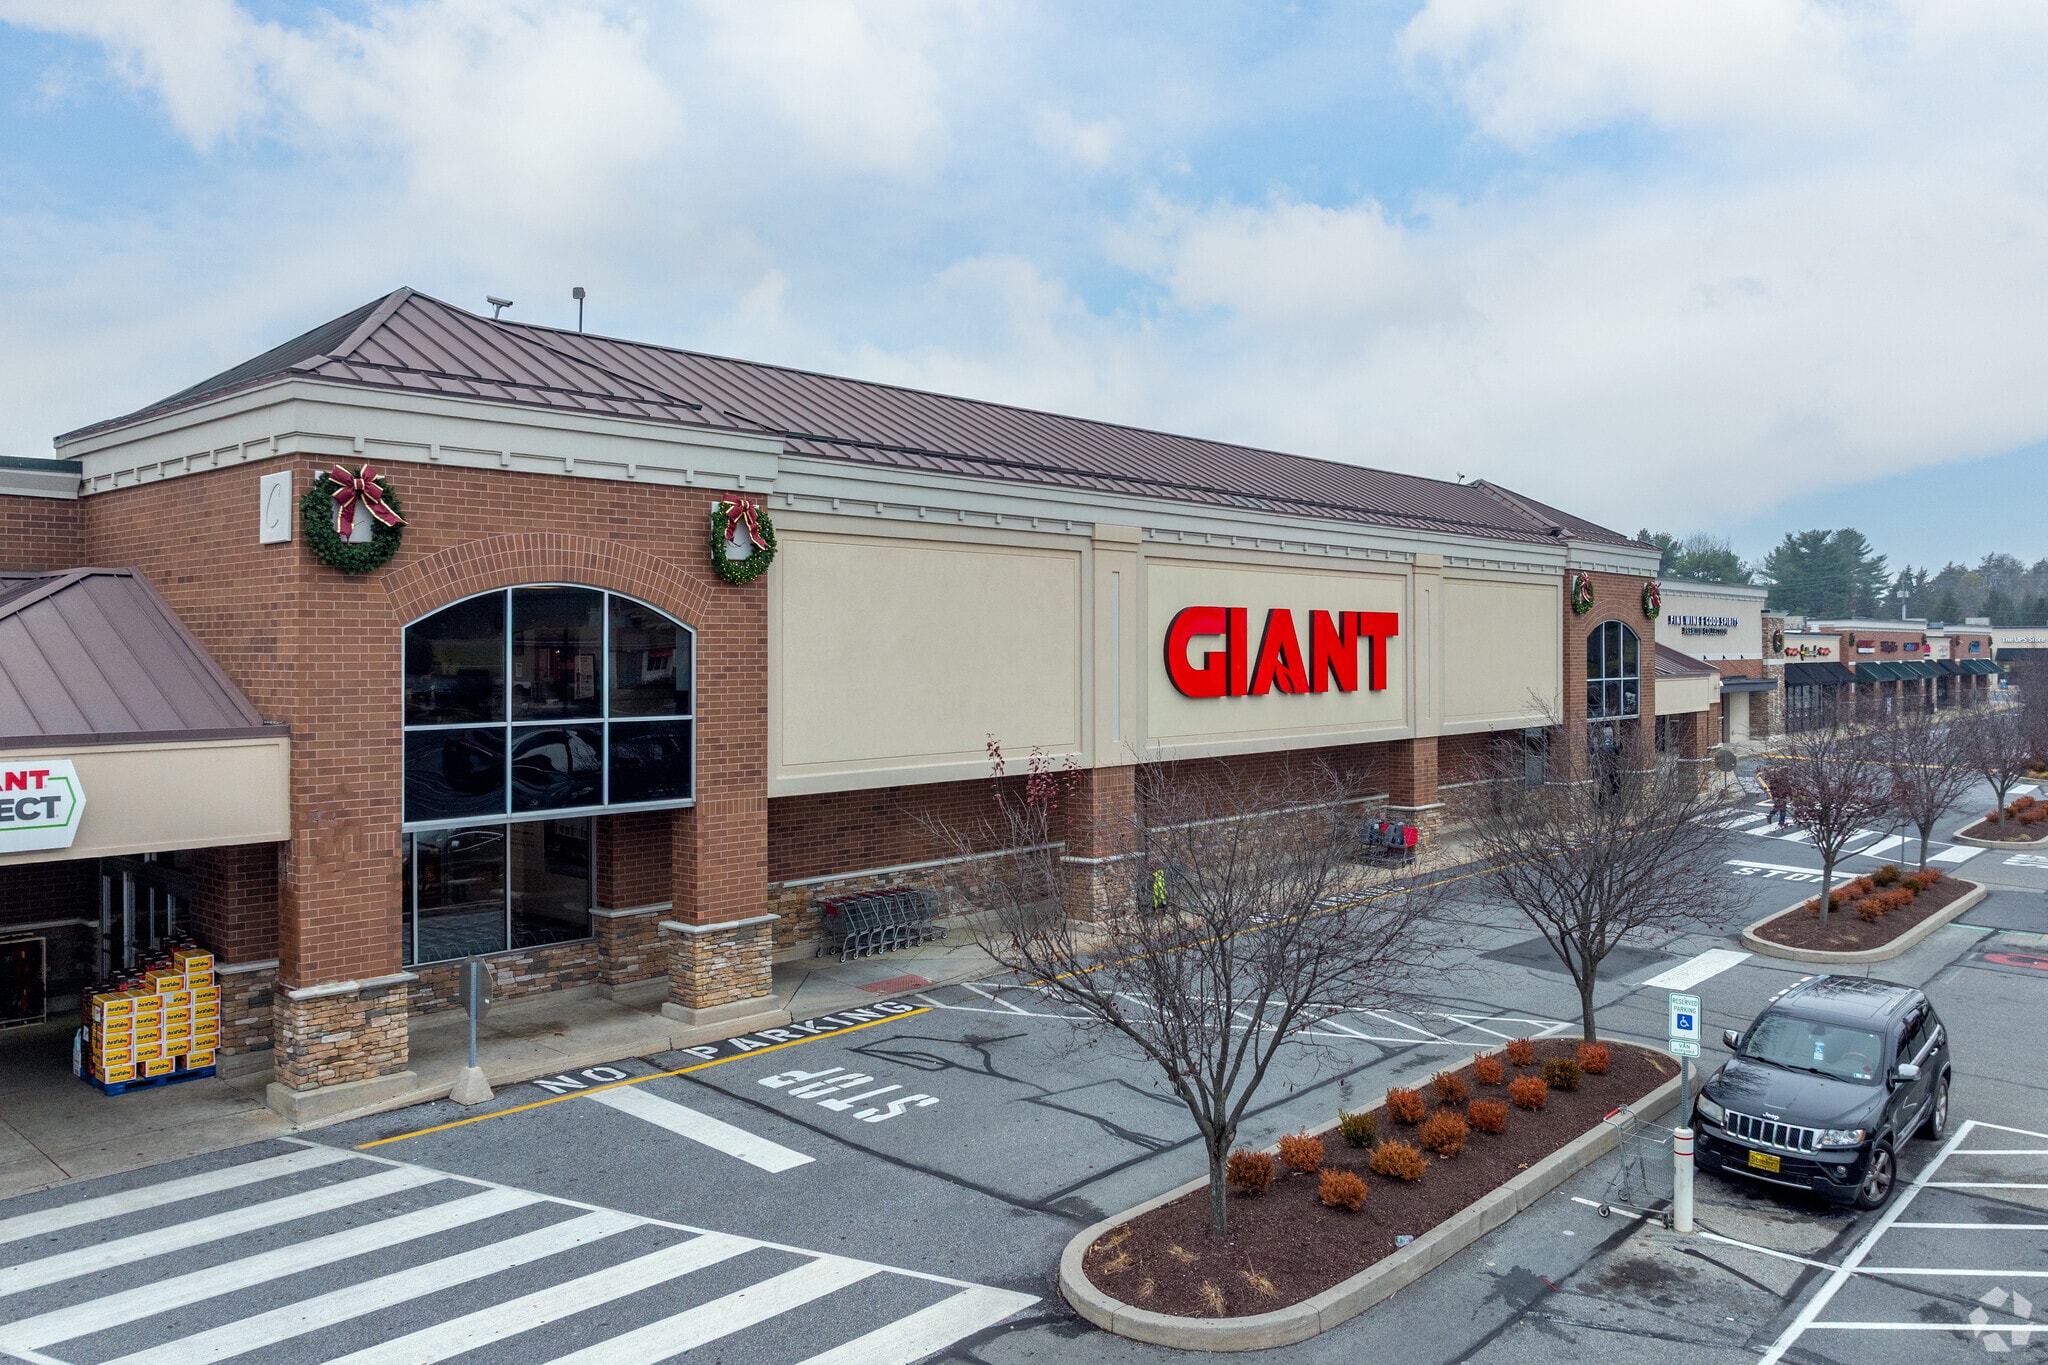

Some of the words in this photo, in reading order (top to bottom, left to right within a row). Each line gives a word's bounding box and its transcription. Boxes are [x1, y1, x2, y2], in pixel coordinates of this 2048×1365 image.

[1668, 615, 1683, 626] FINE
[1684, 616, 1700, 627] WINE
[1705, 616, 1720, 627] GOOD
[1163, 606, 1399, 698] GIANT
[0, 770, 50, 791] NT
[1672, 997, 1698, 1007] RESERVED
[1673, 1005, 1697, 1014] PARKING
[533, 1066, 628, 1094] NO
[682, 1001, 914, 1060] PARKING
[758, 1067, 940, 1122] STOP
[1762, 1111, 1780, 1120] Jeep
